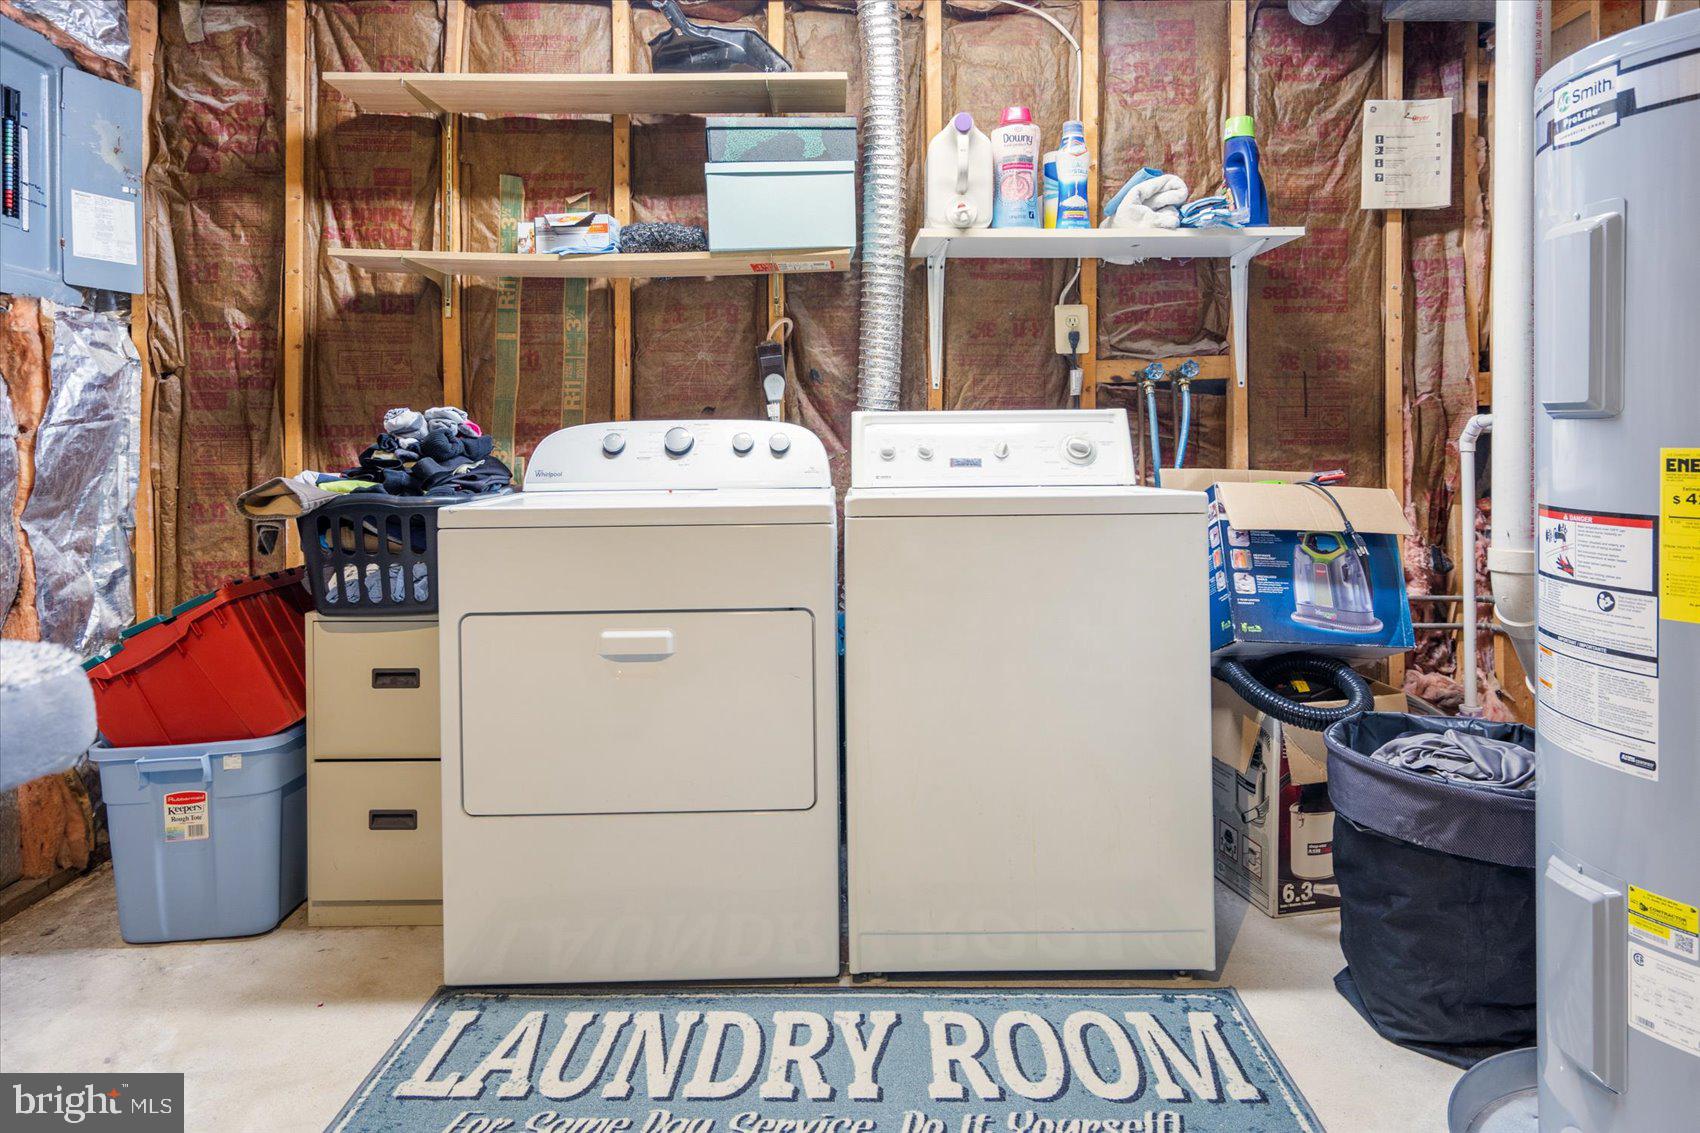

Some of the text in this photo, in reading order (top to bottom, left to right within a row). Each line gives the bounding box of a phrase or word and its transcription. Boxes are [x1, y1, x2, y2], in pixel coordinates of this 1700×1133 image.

[1572, 79, 1611, 104] Smith
[1003, 134, 1033, 145] Downy
[535, 470, 563, 478] Whirlpool
[1568, 513, 1593, 524] DANGER
[168, 794, 205, 802] Rubbermaid
[168, 804, 202, 815] Keepers
[171, 814, 190, 823] Rough
[1282, 881, 1313, 903] 6.3
[393, 1010, 1268, 1103] LAUNDRY ROOM
[441, 1111, 515, 1133] For
[902, 1111, 948, 1133] Do
